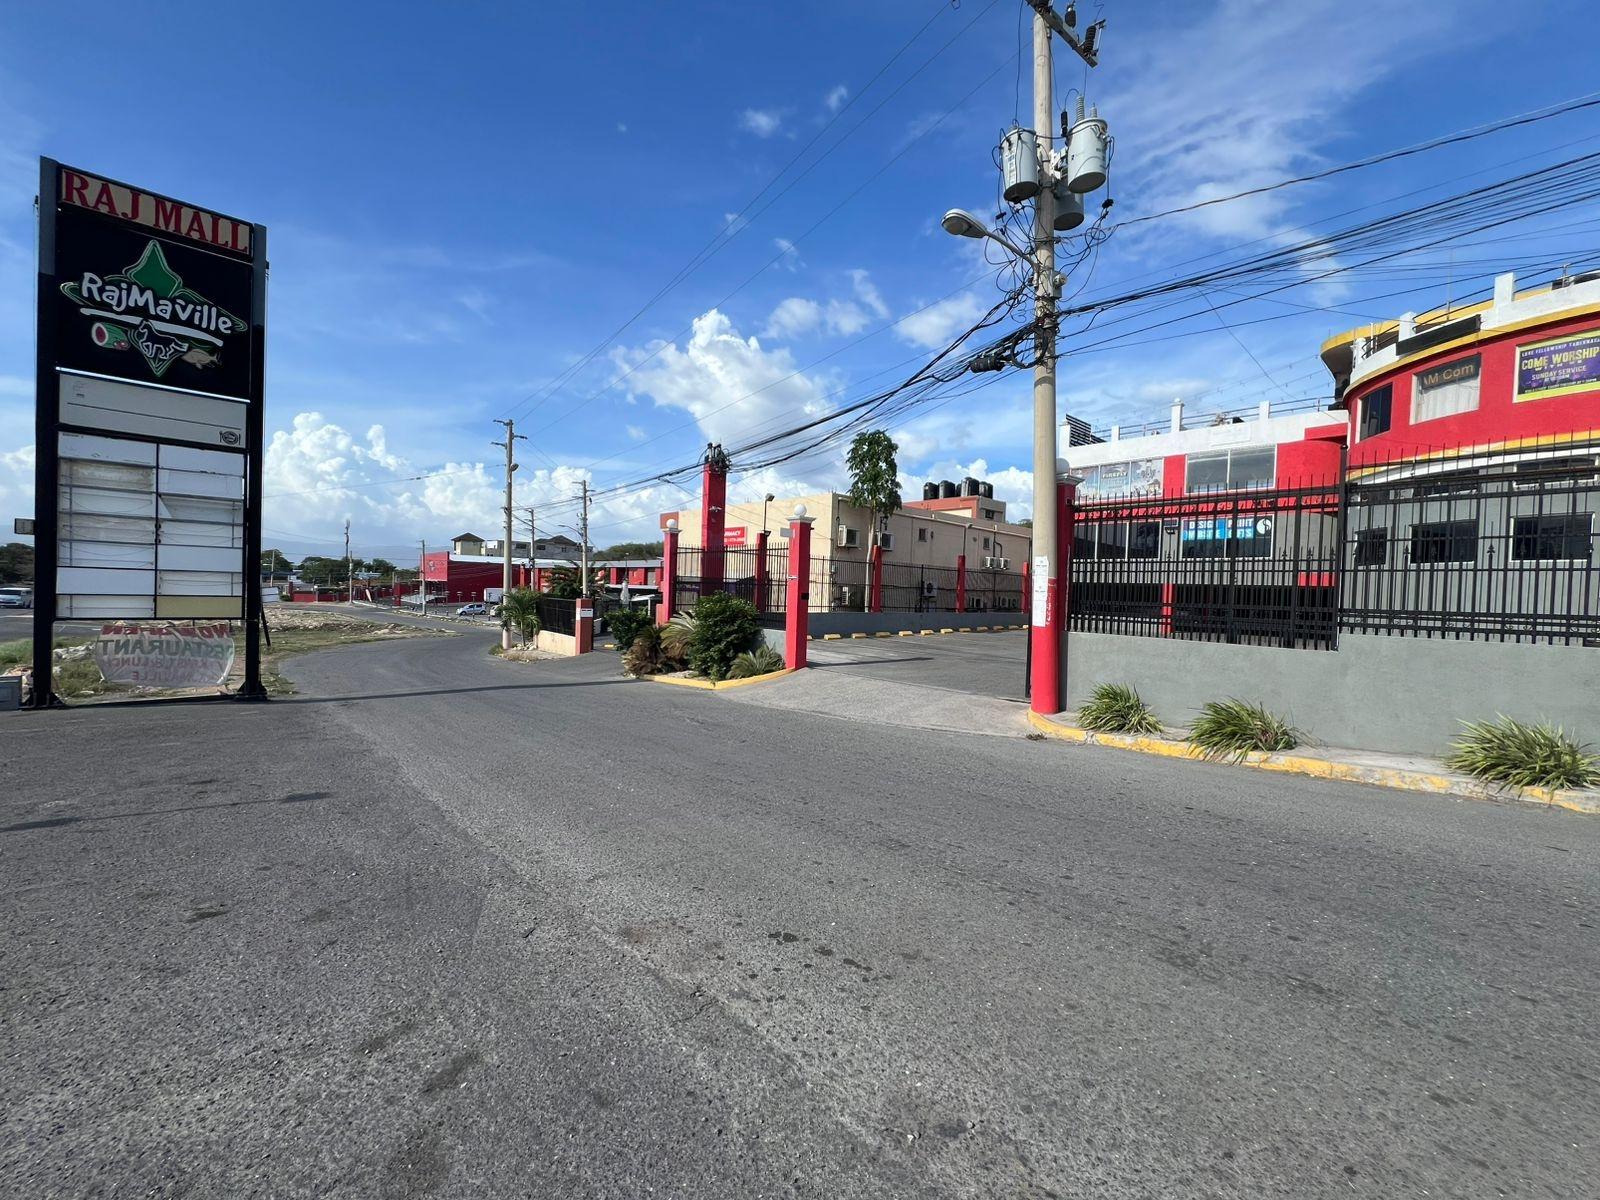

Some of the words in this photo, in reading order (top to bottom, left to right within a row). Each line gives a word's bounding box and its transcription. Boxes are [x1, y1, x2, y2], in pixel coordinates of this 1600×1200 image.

[64, 170, 141, 221] RAJ
[153, 197, 248, 250] MALL
[1521, 355, 1549, 370] COME
[1552, 346, 1600, 365] WORSHIP
[1531, 370, 1557, 380] SUNDAY
[1558, 365, 1587, 375] SERVICE
